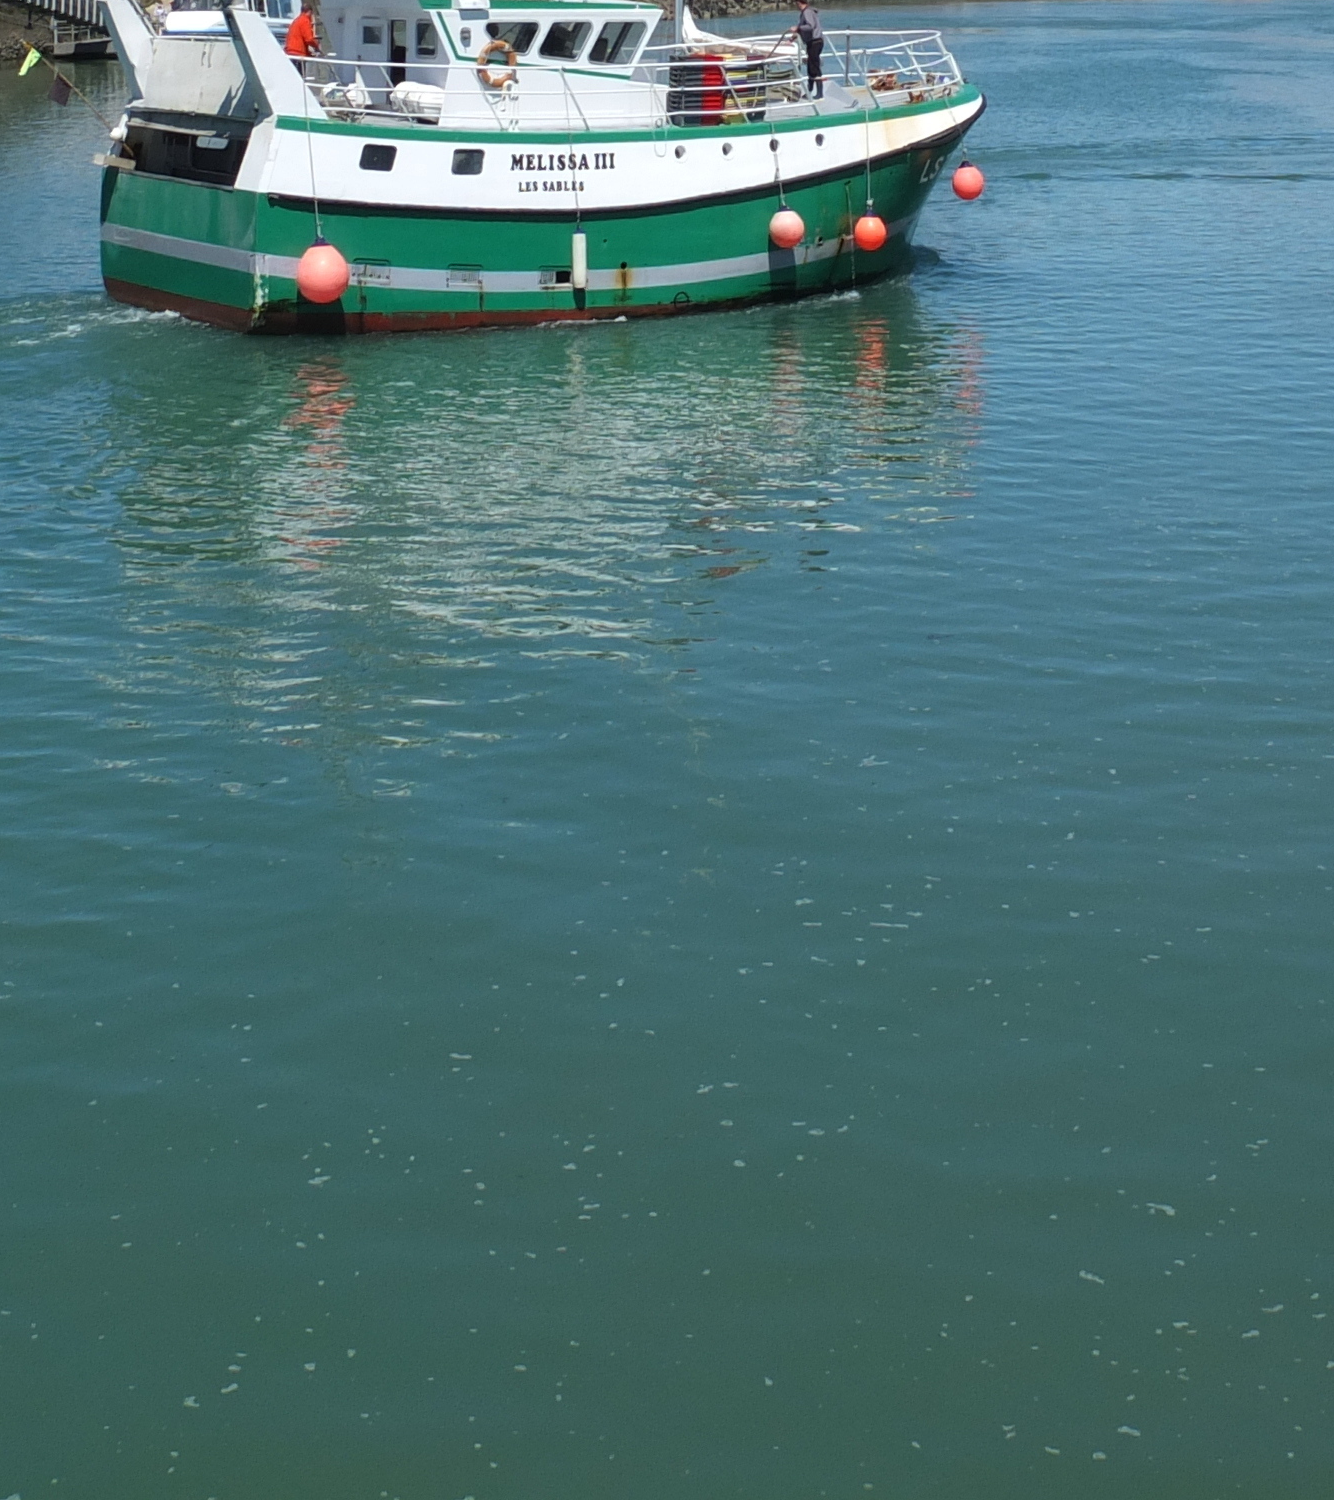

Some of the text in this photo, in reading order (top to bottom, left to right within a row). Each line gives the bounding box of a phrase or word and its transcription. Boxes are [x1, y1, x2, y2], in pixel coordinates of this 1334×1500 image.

[510, 152, 616, 171] MELISSA III
[518, 180, 585, 193] LES SABLES
